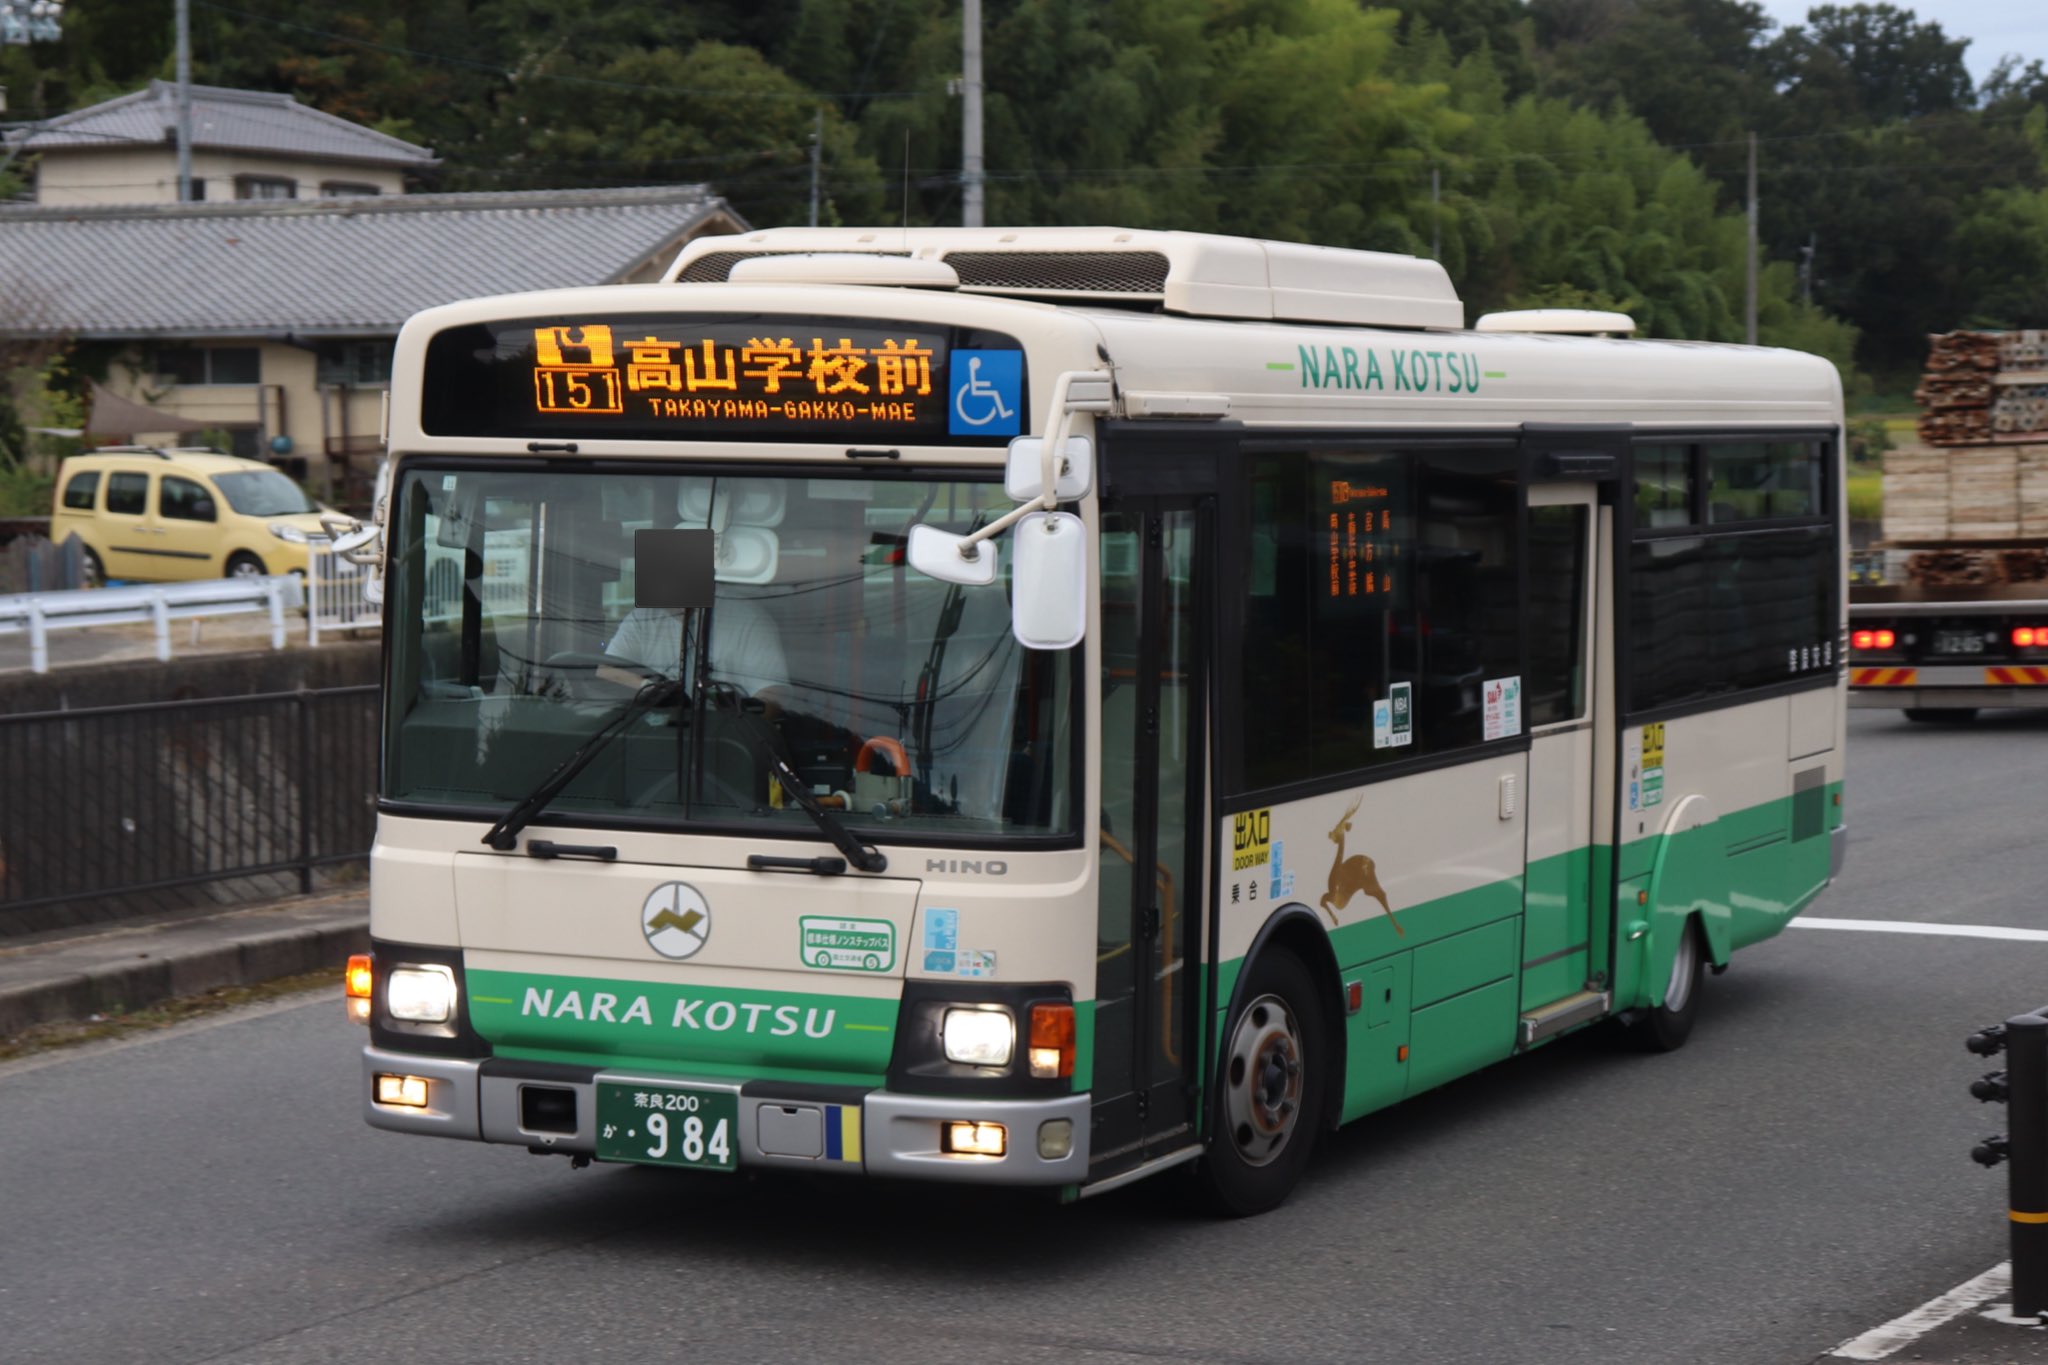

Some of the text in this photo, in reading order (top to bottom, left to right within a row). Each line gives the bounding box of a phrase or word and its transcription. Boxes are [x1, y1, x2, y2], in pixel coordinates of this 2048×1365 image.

[623, 336, 933, 395] 高山学校前
[1298, 344, 1480, 394] NARA KOTSU
[541, 371, 616, 409] 151
[648, 398, 917, 421] TAKAYAMA-GAKKO-MAE
[1234, 811, 1270, 851] 出入口
[926, 859, 1008, 876] HINO
[521, 987, 836, 1039] NARA KOTSU
[633, 1092, 699, 1113] 奈良200
[602, 1124, 618, 1139] か
